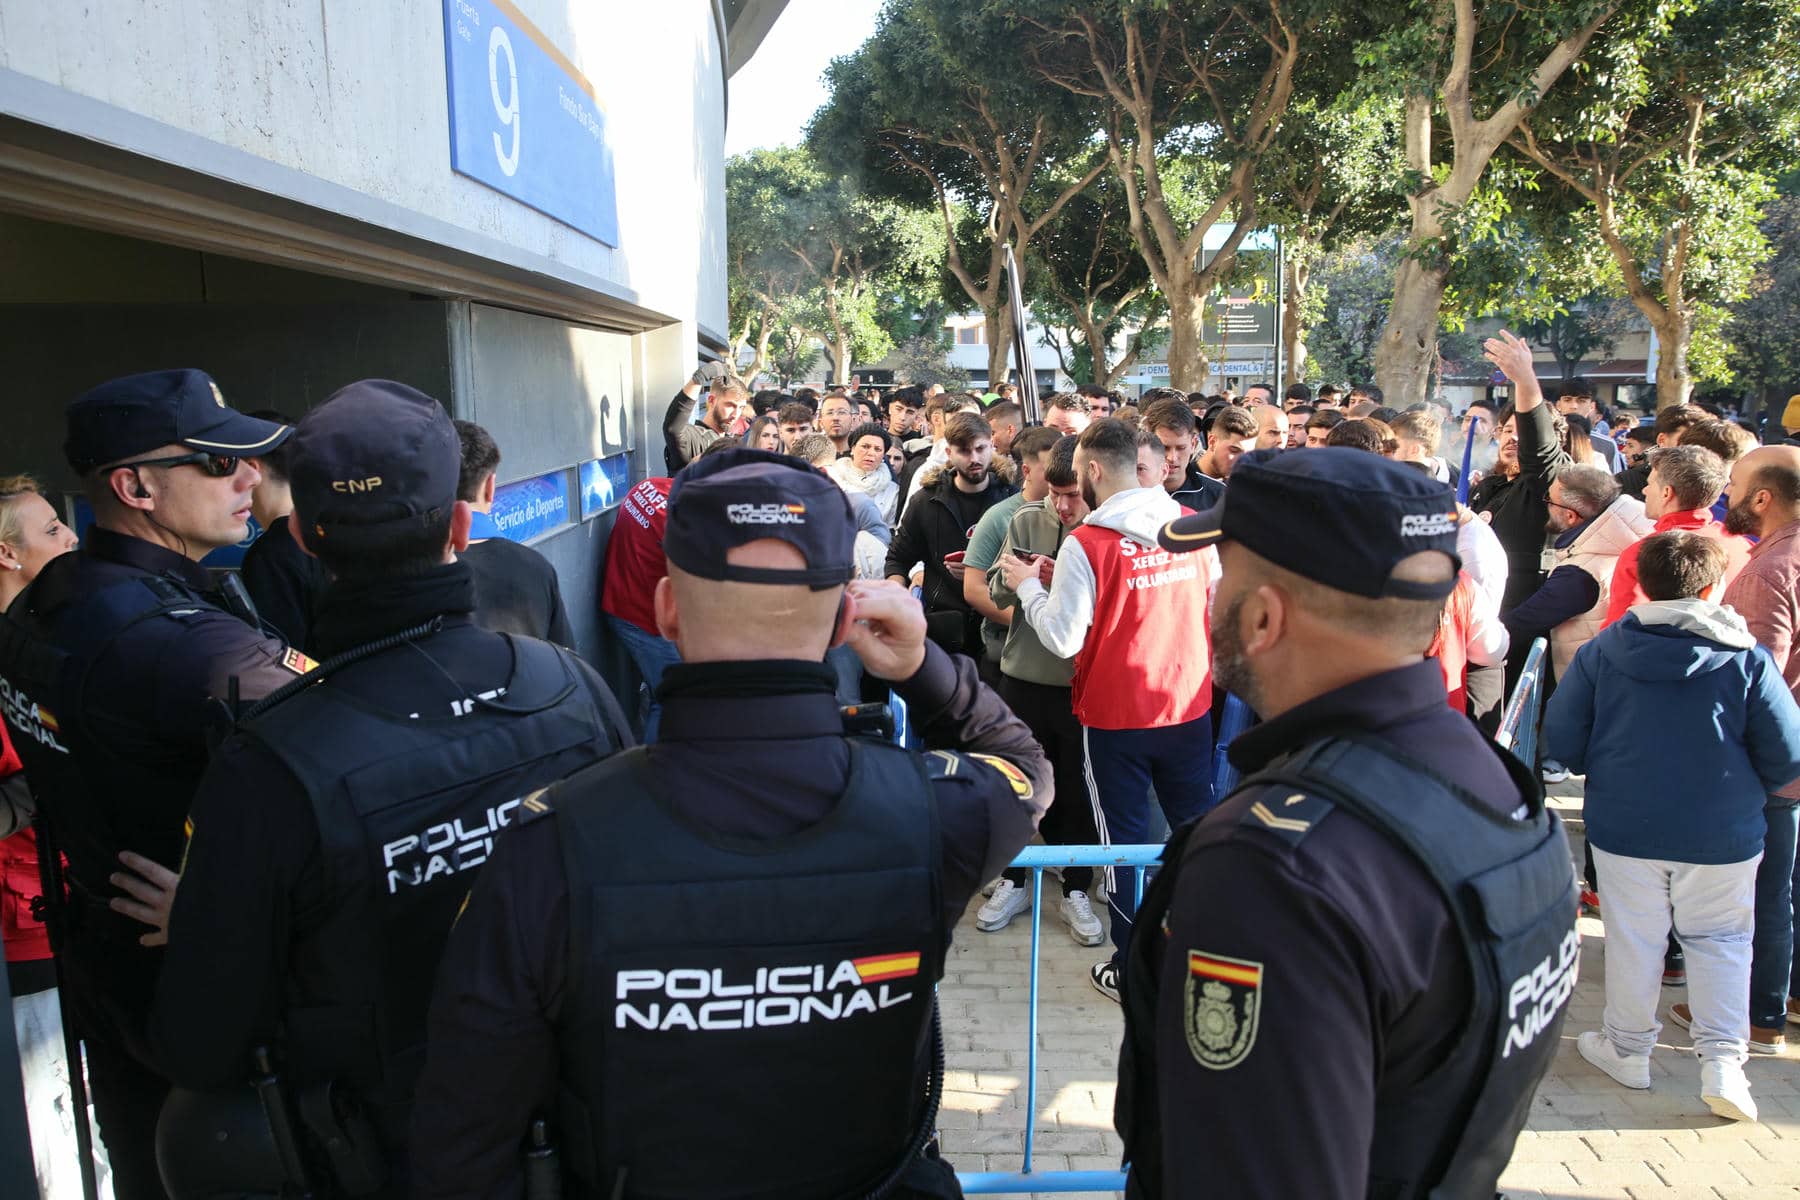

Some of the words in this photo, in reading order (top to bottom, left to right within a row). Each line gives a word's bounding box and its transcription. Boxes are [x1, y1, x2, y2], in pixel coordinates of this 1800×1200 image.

[489, 26, 520, 177] 9
[1147, 366, 1169, 374] DENT
[332, 476, 382, 494] CNP
[638, 481, 668, 509] STAFF
[494, 505, 525, 531] Servicio
[525, 501, 535, 521] de
[535, 495, 564, 520] Deportes
[727, 503, 790, 516] POLICIA
[728, 513, 806, 525] NACIONAL
[1132, 551, 1171, 571] XEREZ
[1126, 565, 1197, 590] VOLUNTARIO
[383, 797, 521, 868] POLIC
[387, 836, 495, 894] NACI
[616, 959, 862, 1000] POLICIA
[615, 985, 912, 1031] NACIONAL
